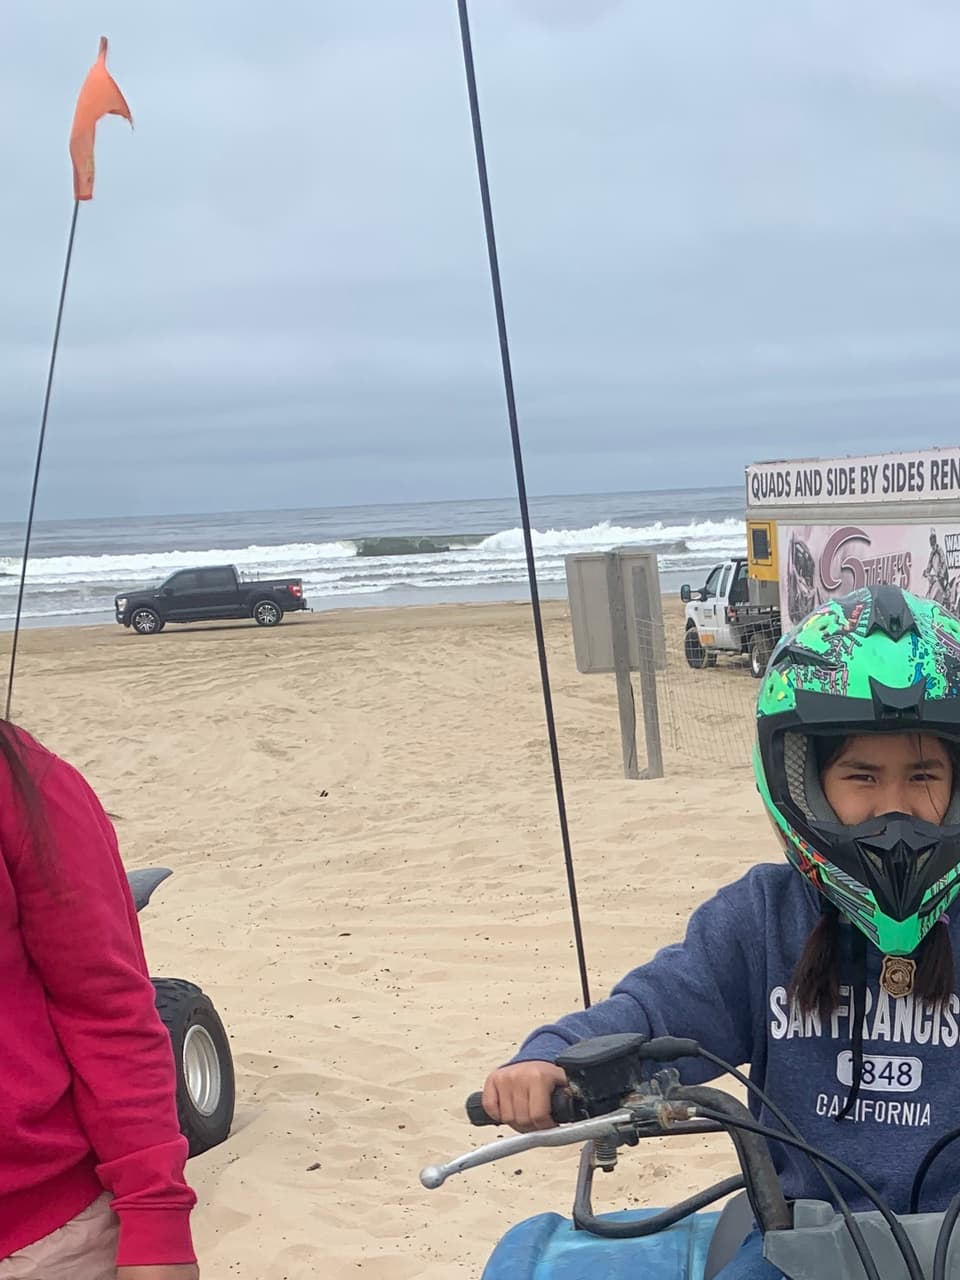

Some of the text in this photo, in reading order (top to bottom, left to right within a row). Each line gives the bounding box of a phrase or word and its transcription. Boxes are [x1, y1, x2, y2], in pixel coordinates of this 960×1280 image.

[751, 470, 792, 500] QUADS
[794, 468, 823, 497] AND
[826, 466, 856, 496] SIDE
[860, 464, 879, 494] BY
[882, 460, 925, 494] SIDES
[769, 985, 822, 1040] SAN
[846, 1058, 913, 1087] 848
